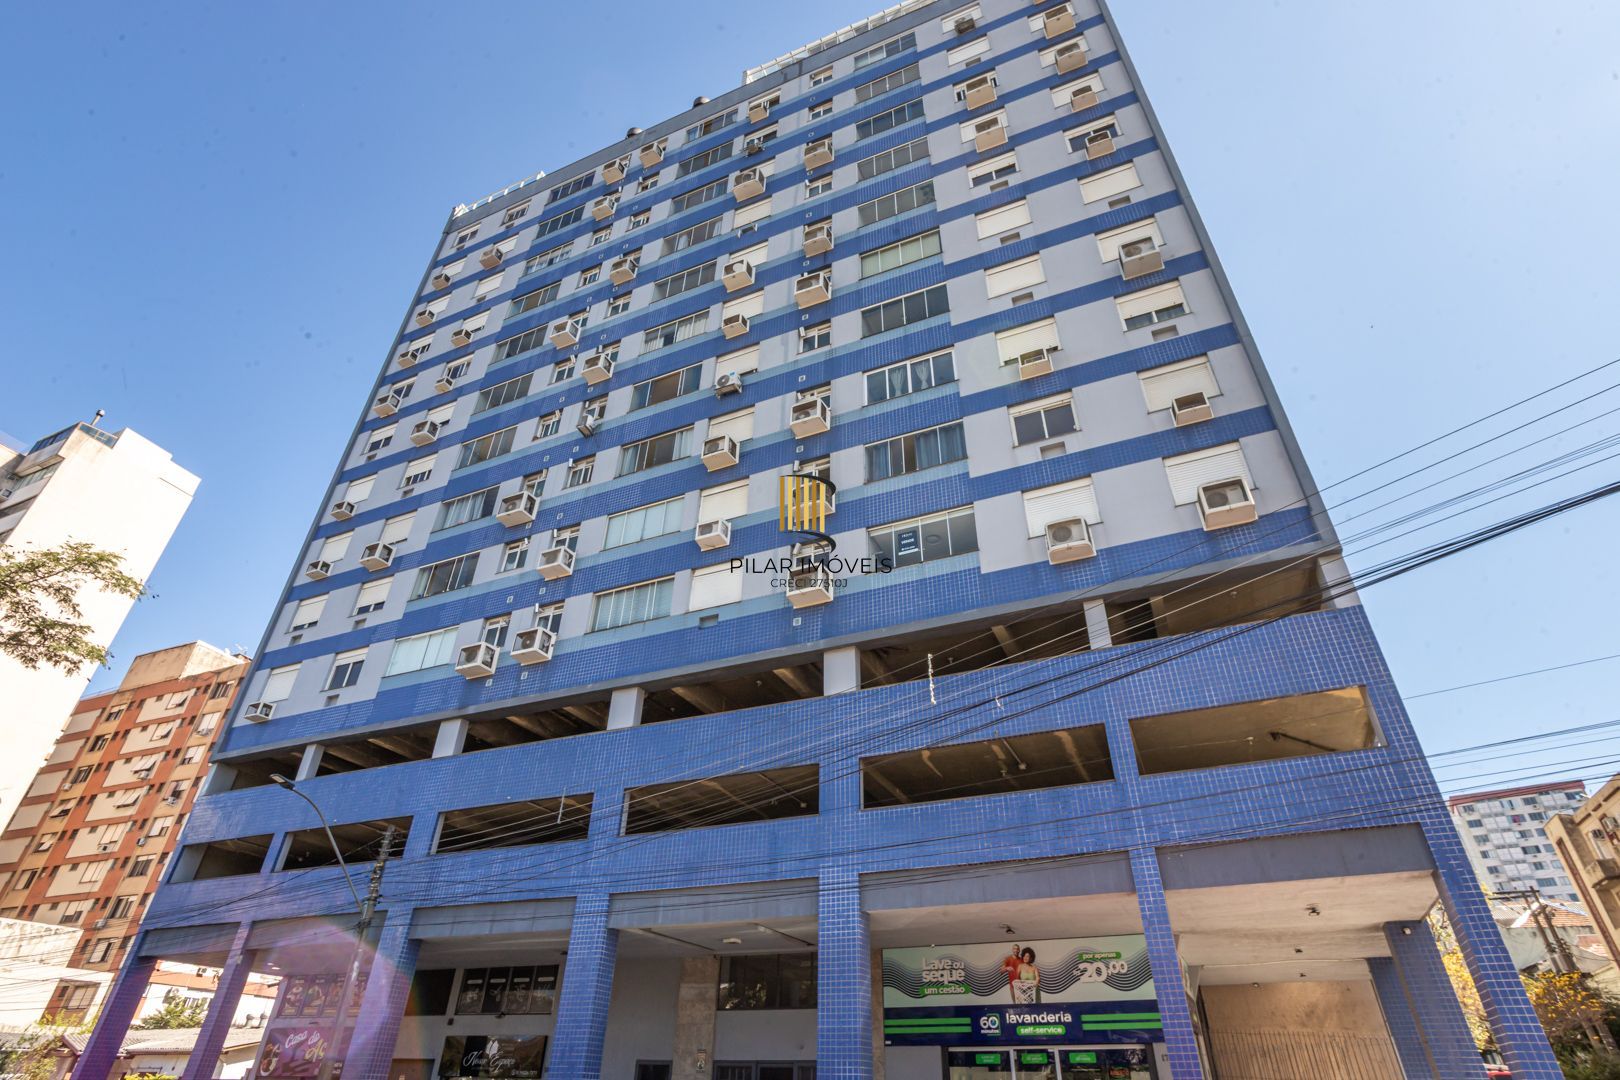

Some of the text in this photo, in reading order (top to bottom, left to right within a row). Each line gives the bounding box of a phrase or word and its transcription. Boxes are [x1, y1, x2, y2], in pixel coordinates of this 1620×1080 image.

[922, 958, 965, 970] Lave ou
[922, 969, 966, 985] seque
[938, 984, 966, 994] cestão
[979, 1016, 1000, 1029] 60
[1005, 1010, 1073, 1024] lavanderia
[1020, 1026, 1063, 1034] self-service
[285, 1030, 309, 1048] Casa
